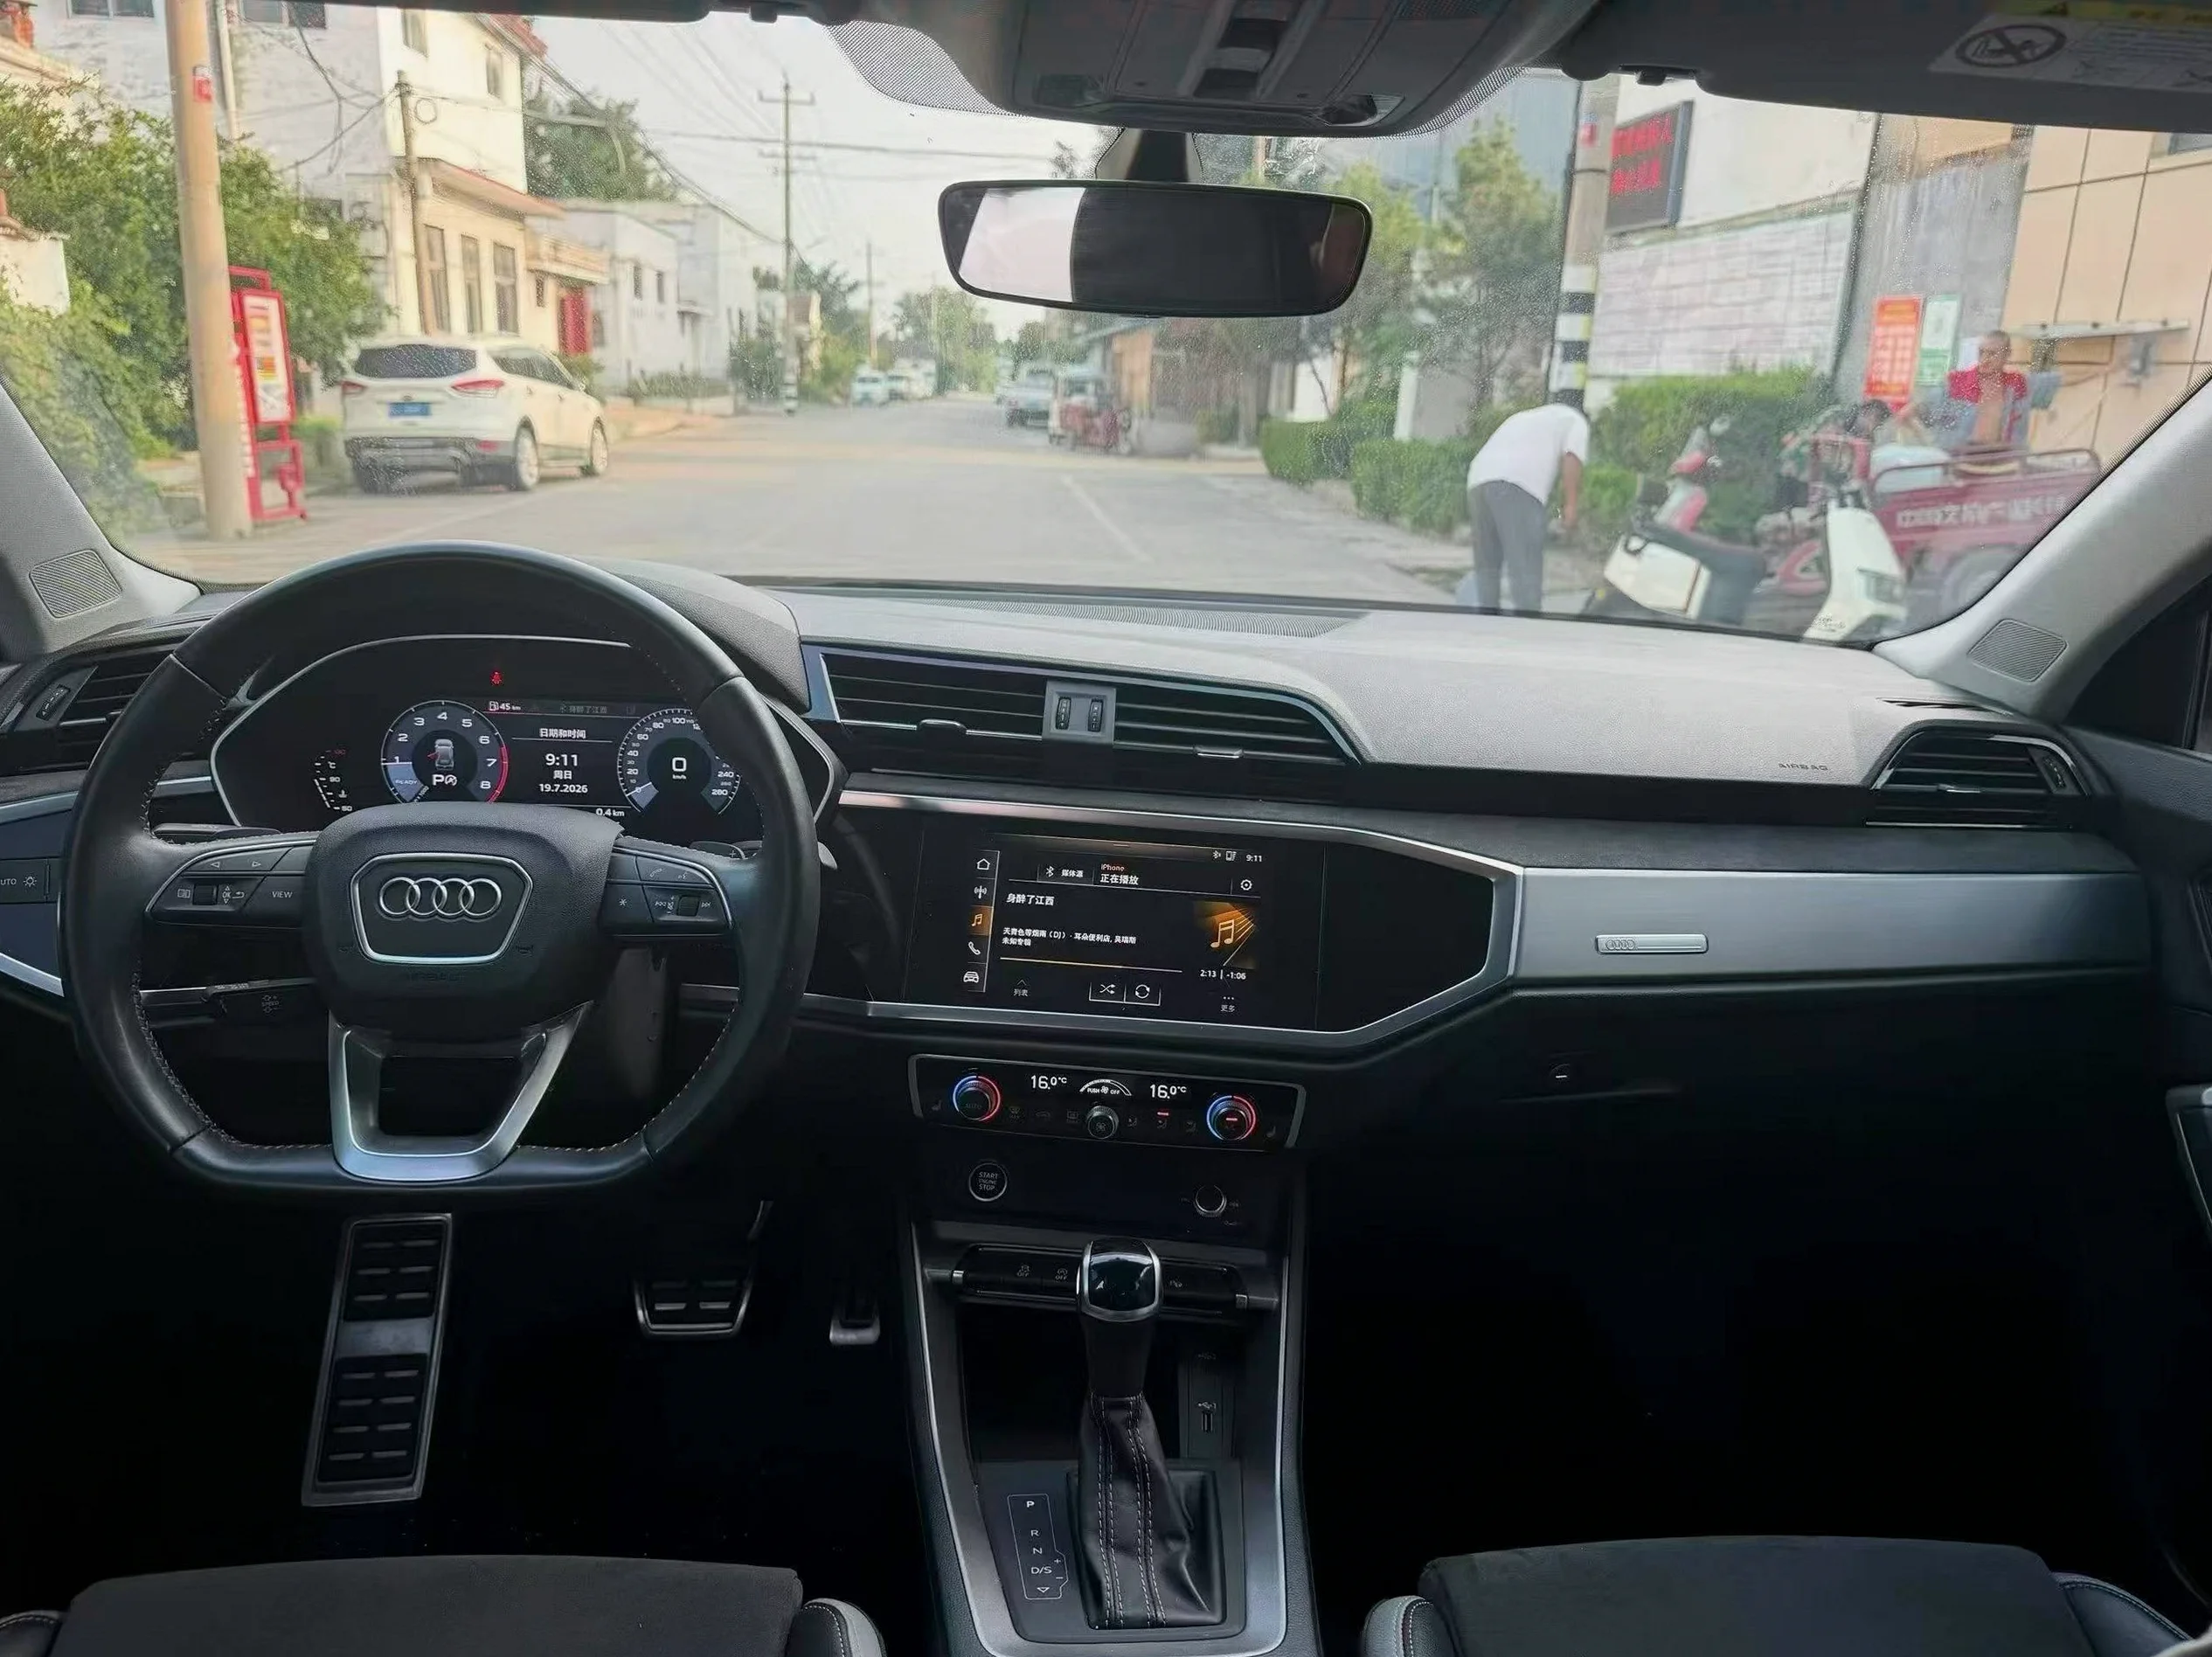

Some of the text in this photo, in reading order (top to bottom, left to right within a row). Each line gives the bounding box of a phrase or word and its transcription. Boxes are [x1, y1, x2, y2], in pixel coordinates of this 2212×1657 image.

[437, 711, 447, 721] 4
[413, 718, 425, 726] 3
[461, 718, 473, 727] 5
[397, 733, 409, 743] 2
[539, 728, 586, 739] 日期和时间
[478, 735, 490, 745] 6
[486, 758, 497, 767] 7
[545, 753, 579, 766] 9:11
[671, 757, 687, 772] 0
[433, 773, 445, 786] P
[553, 770, 572, 780] 周日
[480, 780, 491, 789] 8
[538, 783, 588, 793] 19.7.2026
[595, 808, 612, 816] 0.4
[1245, 854, 1263, 863] 9:11
[1100, 863, 1125, 872] iPhone
[1099, 874, 1139, 885] 正在播放
[1006, 893, 1055, 906] 身醉了江西
[1200, 969, 1217, 978] 2:13
[1014, 988, 1029, 997] 列表
[1220, 1004, 1235, 1013] 更多
[1030, 1566, 1052, 1575] D/S
